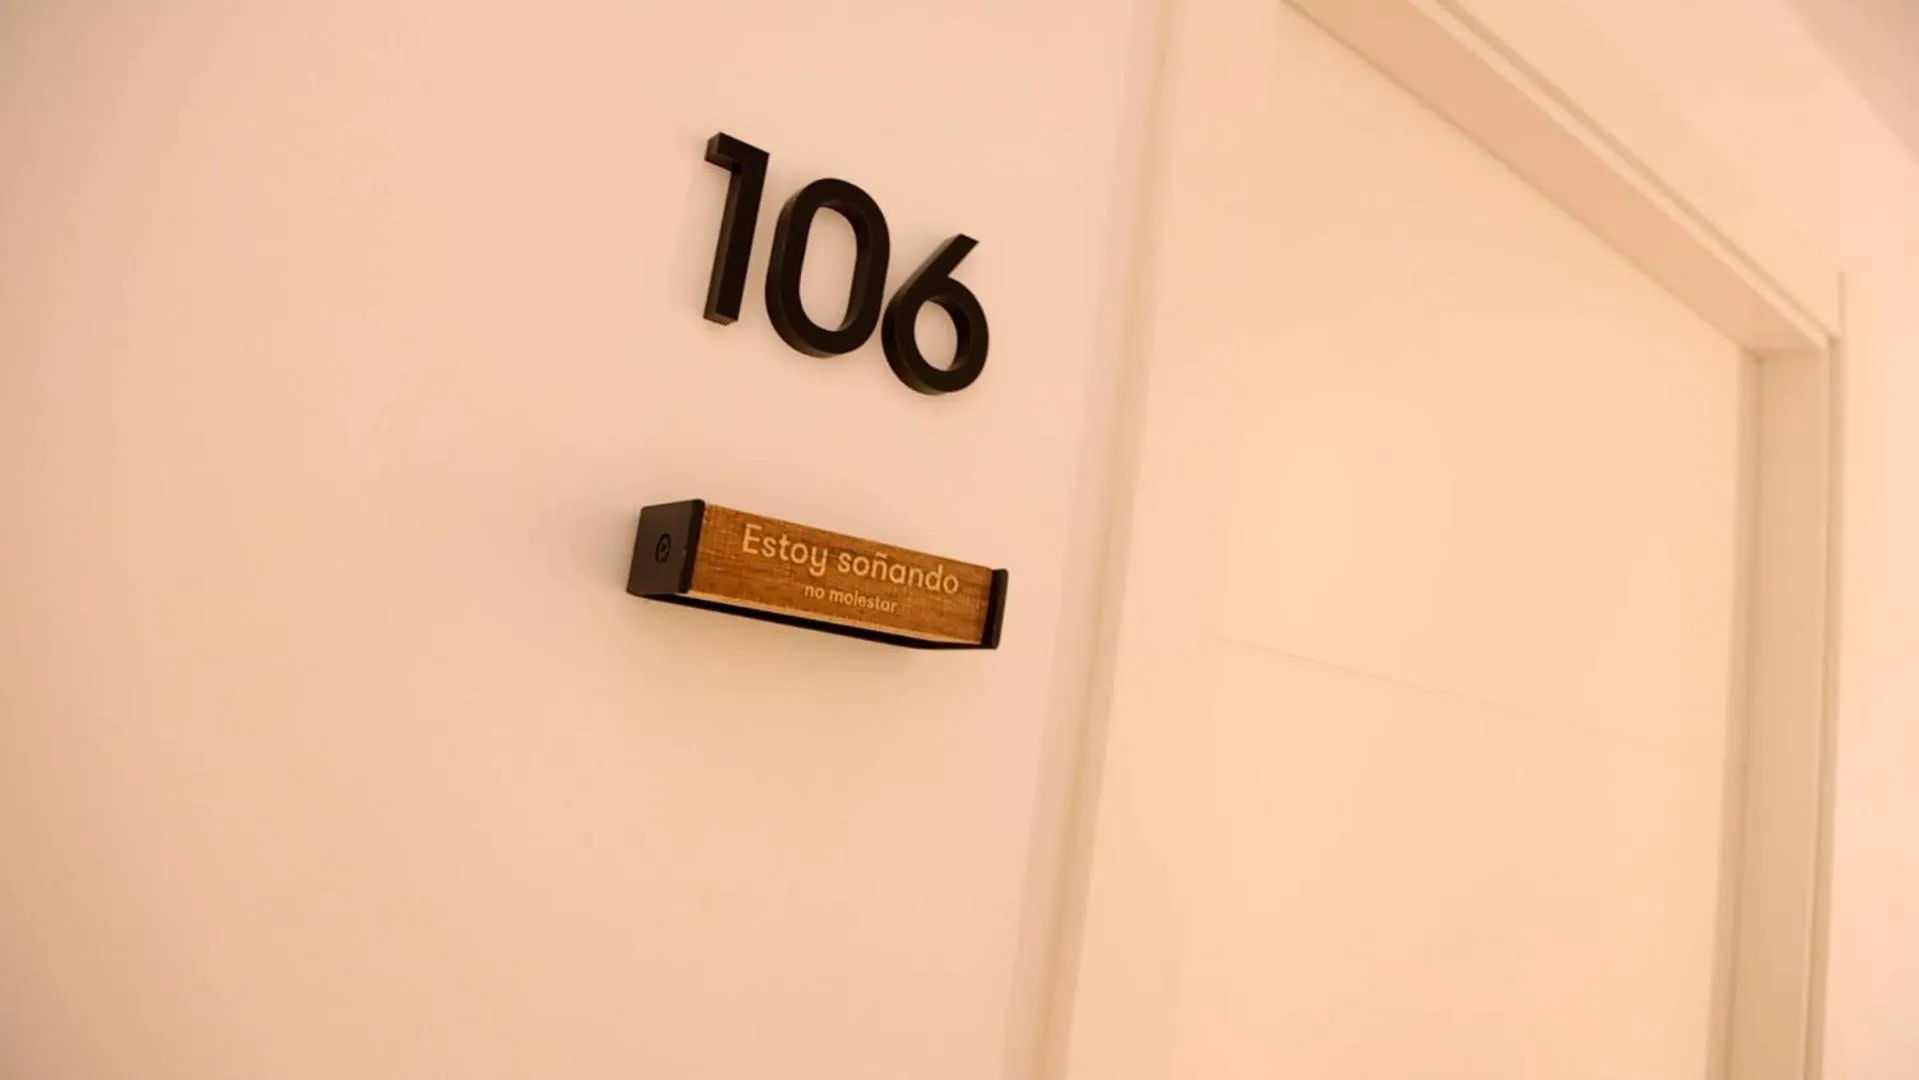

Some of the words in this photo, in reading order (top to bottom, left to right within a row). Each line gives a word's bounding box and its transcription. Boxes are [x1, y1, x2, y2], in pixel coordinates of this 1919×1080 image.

[703, 132, 989, 395] 106
[742, 522, 828, 577] Estoy
[837, 551, 959, 594] soñando
[804, 583, 825, 599] no
[829, 588, 898, 613] molestar
